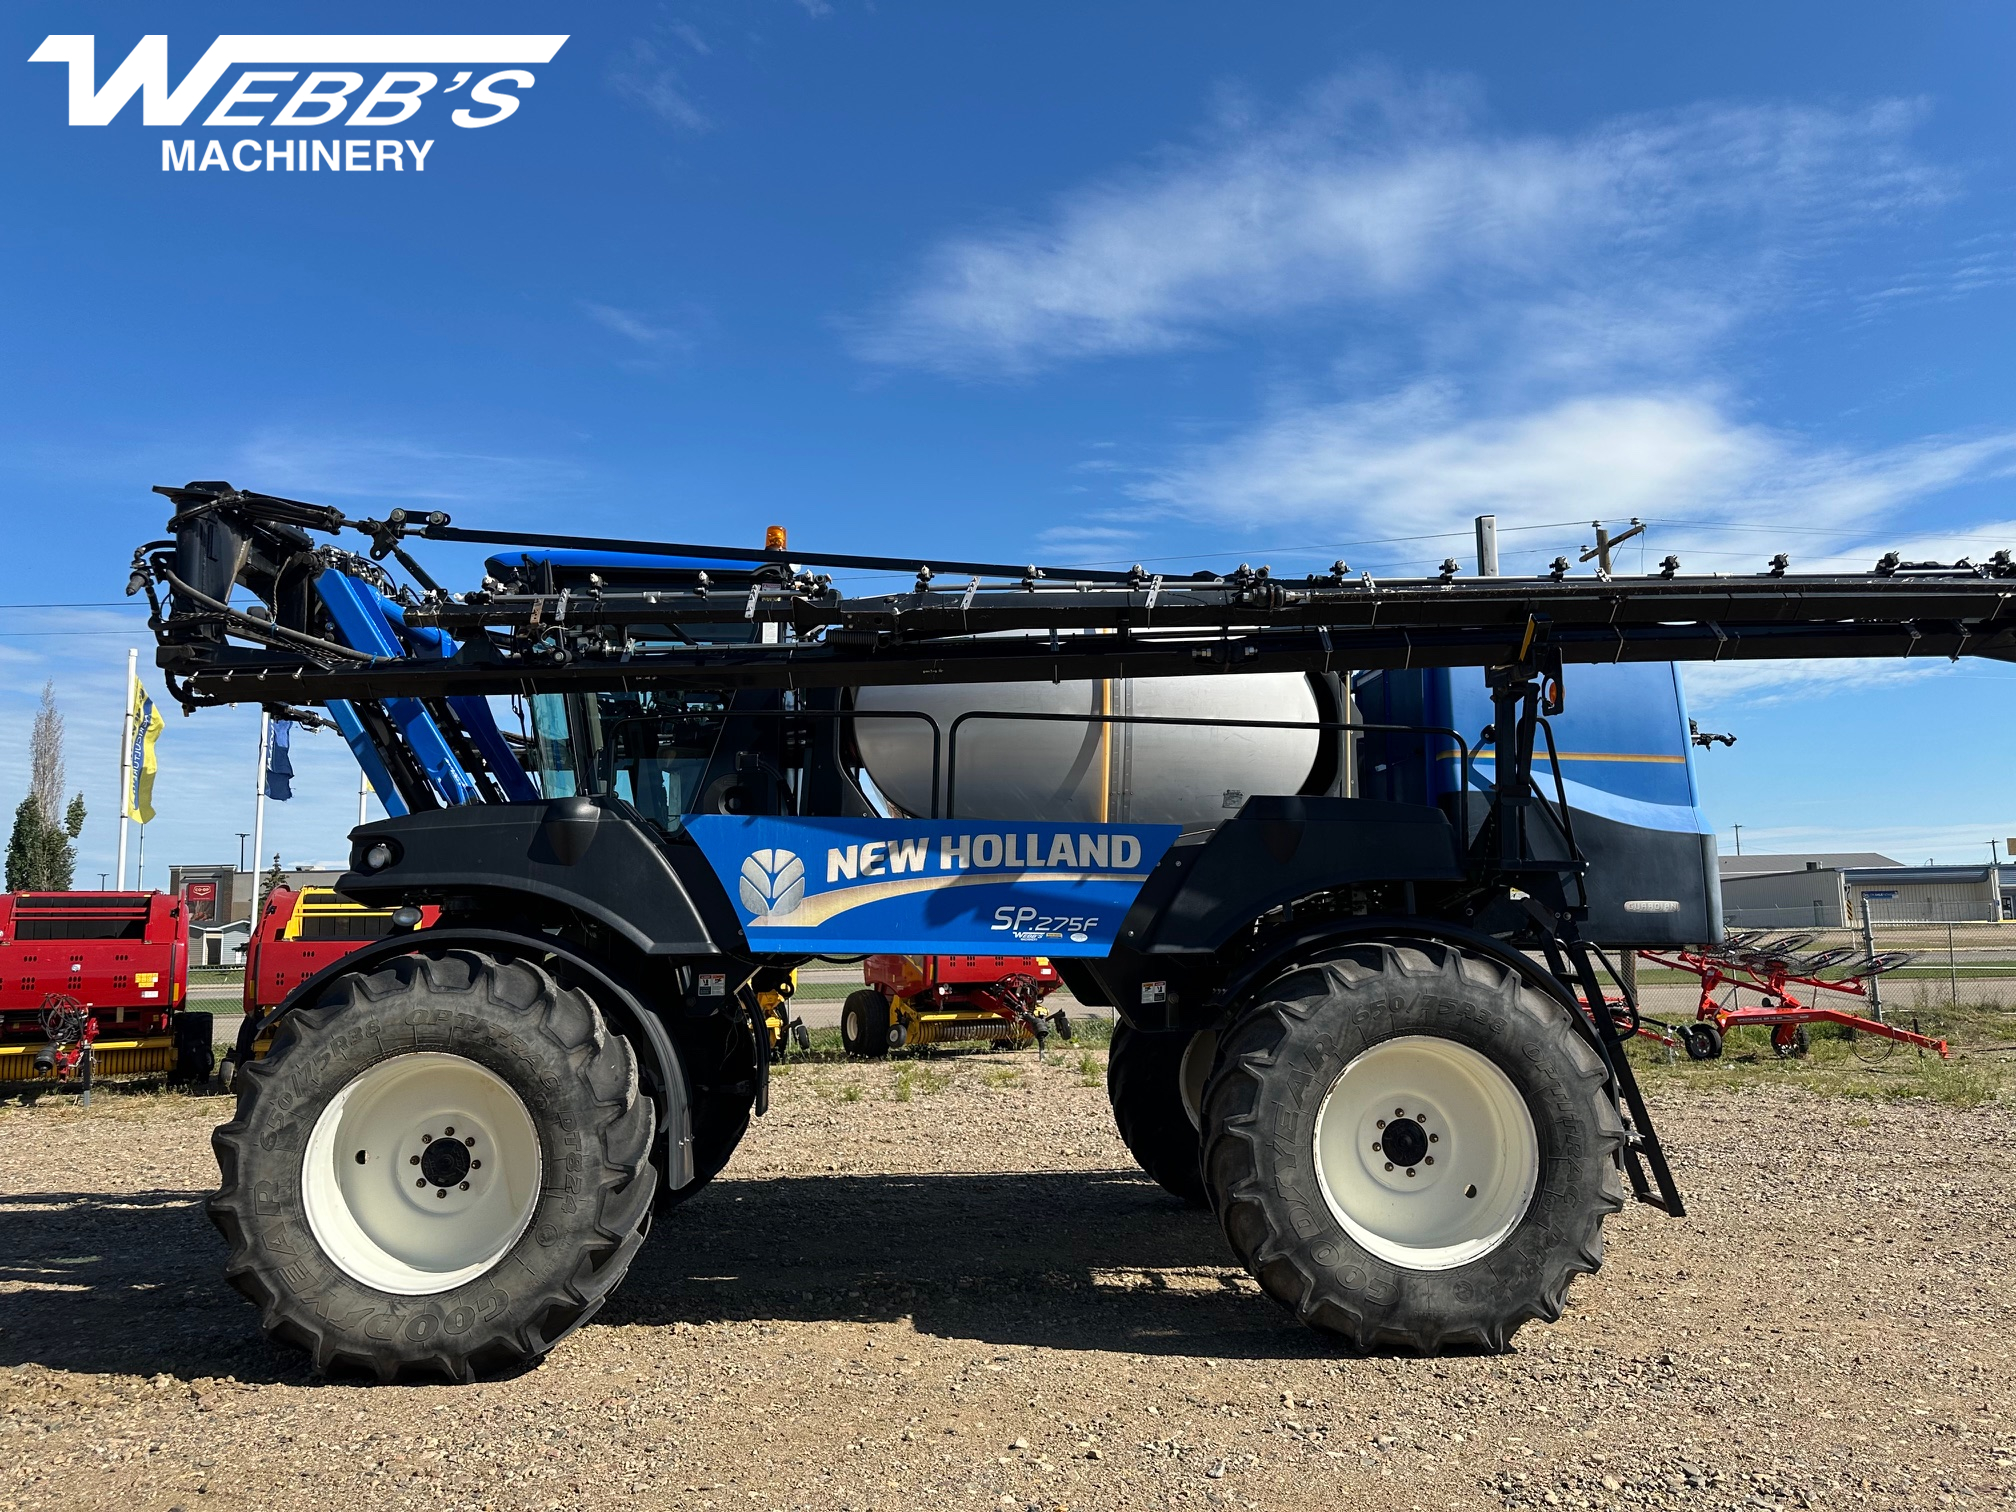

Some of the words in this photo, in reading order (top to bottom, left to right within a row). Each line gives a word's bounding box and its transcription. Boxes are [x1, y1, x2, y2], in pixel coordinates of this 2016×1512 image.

[826, 837, 929, 883] NEW
[940, 833, 1141, 869] HOLLAND
[1627, 902, 1679, 911] GUARDIAN
[557, 1110, 582, 1215] DT824
[1272, 1030, 1400, 1307] GOODYEAR
[255, 1180, 510, 1343] GOODYEAR
